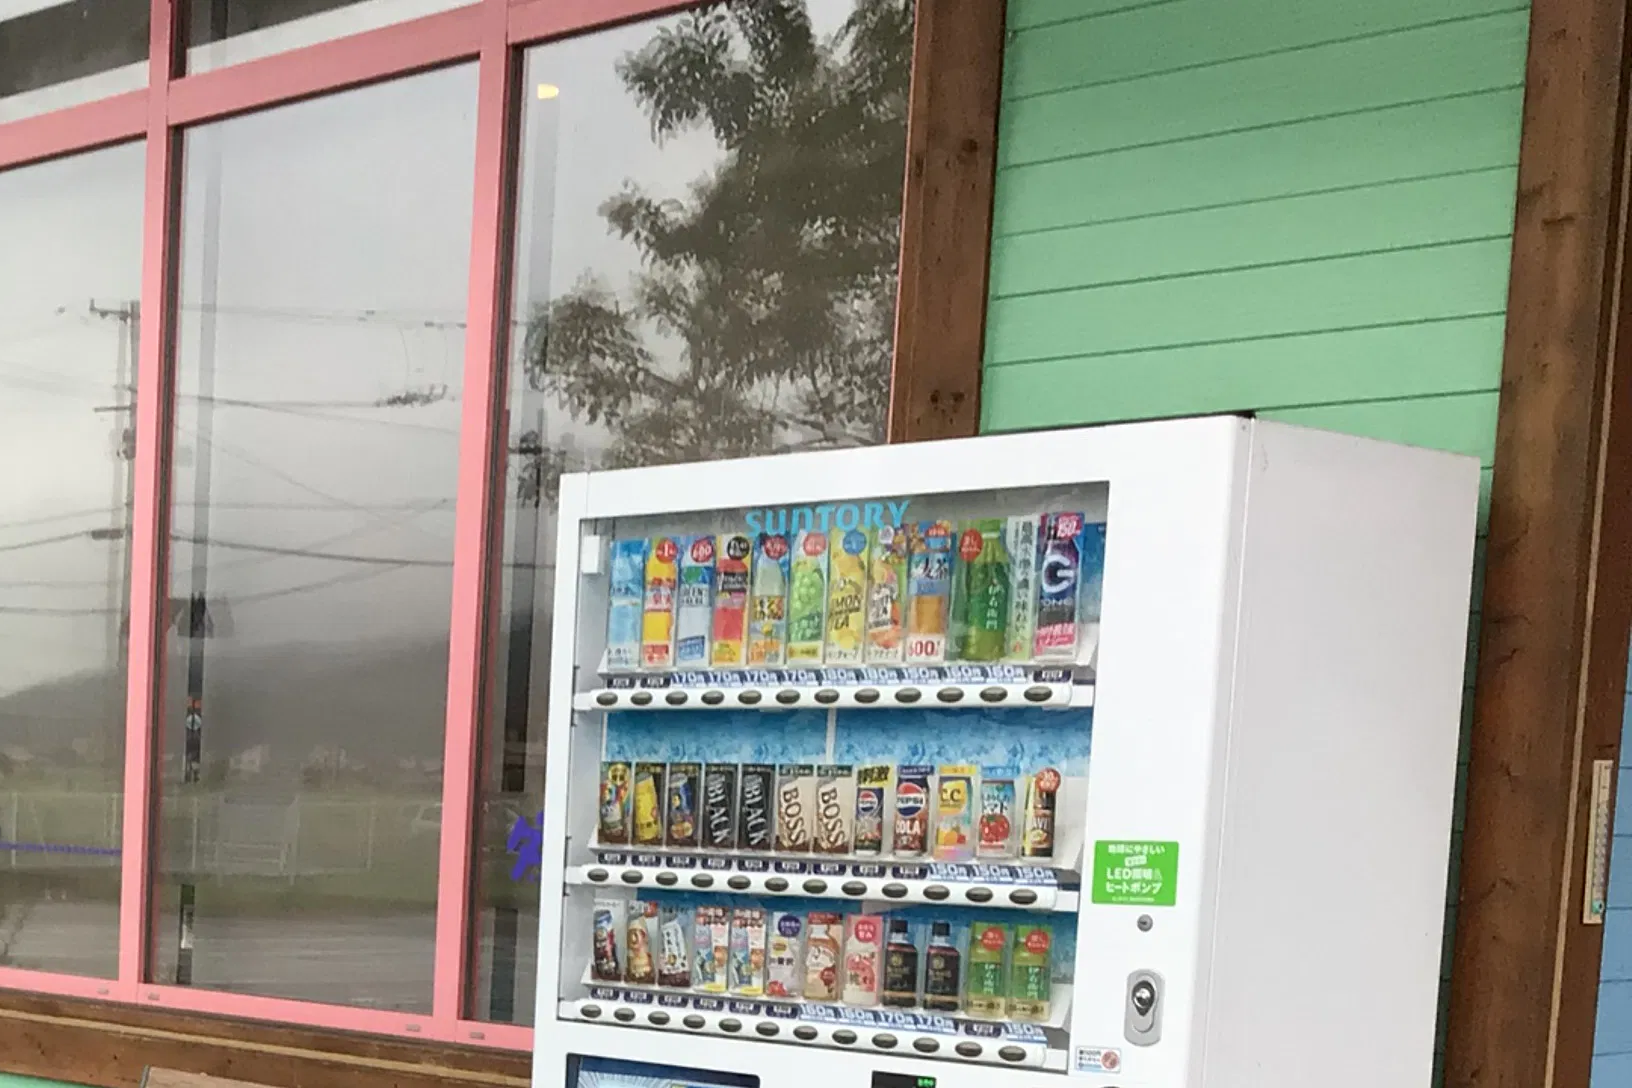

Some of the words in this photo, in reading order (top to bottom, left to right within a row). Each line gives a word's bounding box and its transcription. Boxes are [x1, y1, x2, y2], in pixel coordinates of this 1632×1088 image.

[746, 500, 909, 535] SUNTORY
[708, 785, 732, 844] BLACK
[745, 785, 769, 846] BLACK
[783, 787, 808, 845] BOSS
[821, 787, 846, 845] BOSS
[1106, 881, 1163, 895] ヒートポンプ
